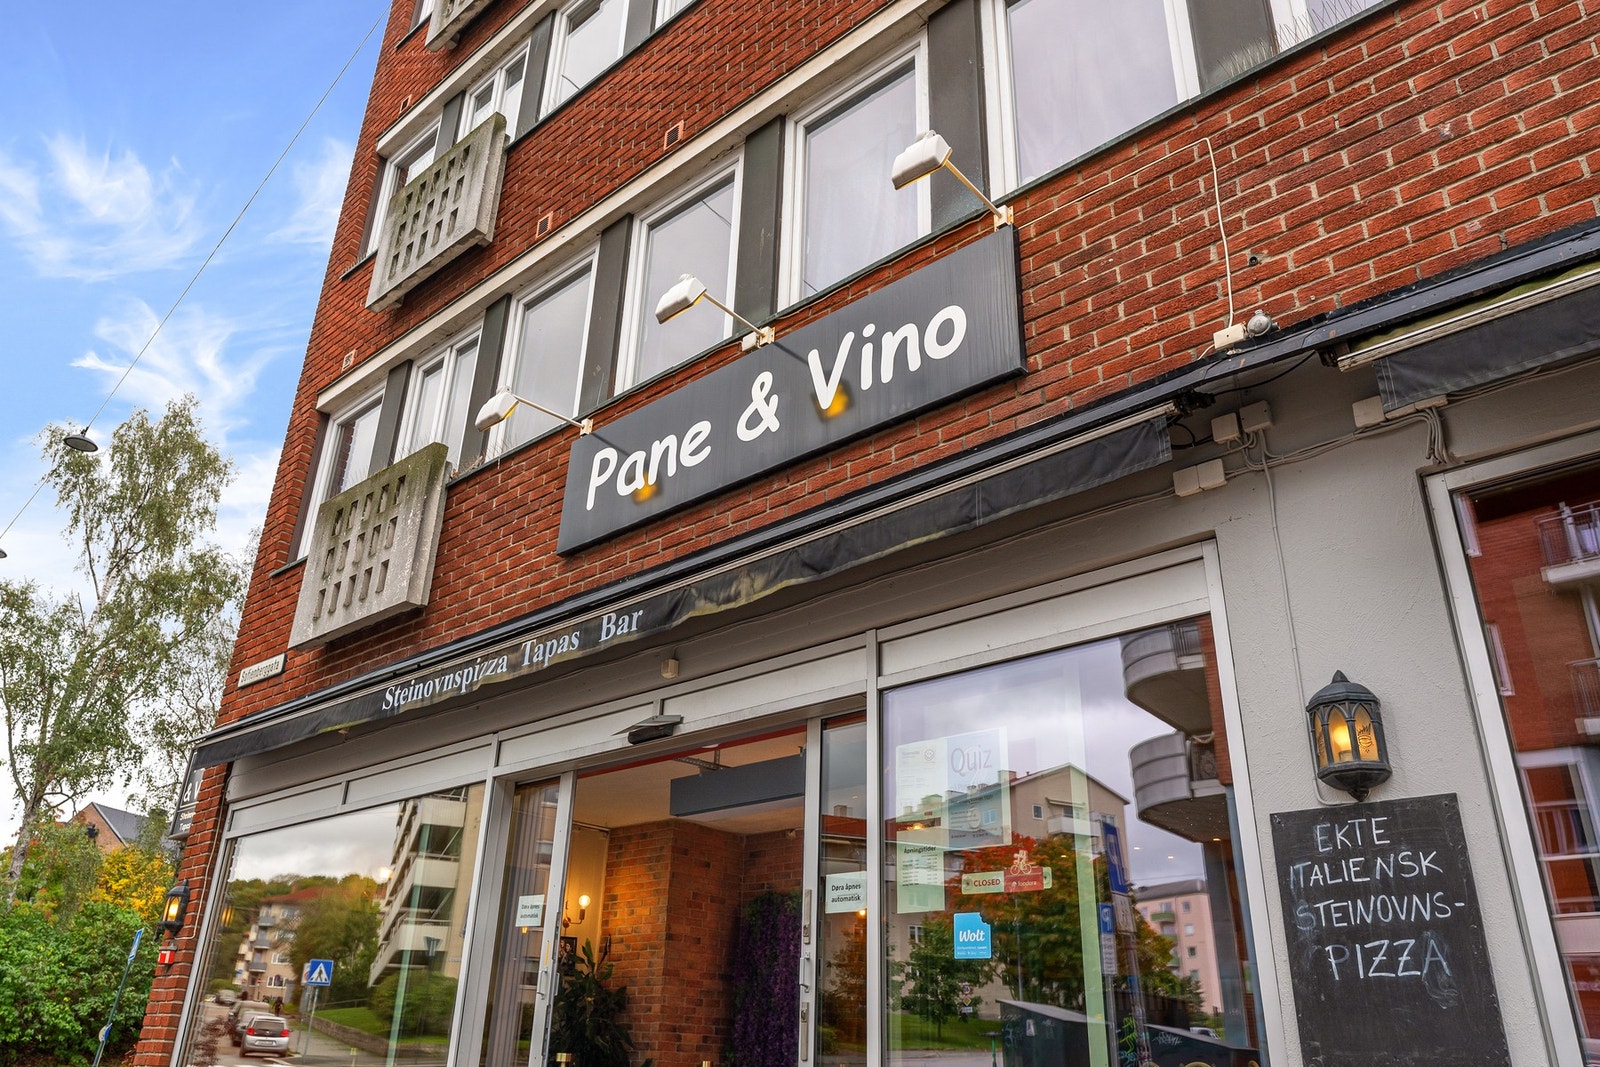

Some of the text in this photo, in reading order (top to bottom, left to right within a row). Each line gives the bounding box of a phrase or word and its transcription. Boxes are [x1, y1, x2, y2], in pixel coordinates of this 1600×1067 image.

[586, 305, 967, 511] Pane & Vino
[381, 609, 644, 710] Steinovnspizza Tapas Bar
[951, 745, 993, 776] Quiz
[1316, 817, 1391, 852] EKTE
[831, 883, 861, 892] Døra åpnes
[973, 878, 1001, 887] CLOSED
[1289, 851, 1443, 889] ITALIENSK
[831, 894, 861, 903] automatisk
[1296, 892, 1465, 930] STEINOVNS-
[959, 929, 985, 942] Wolt
[1325, 939, 1451, 981] PIZZA
